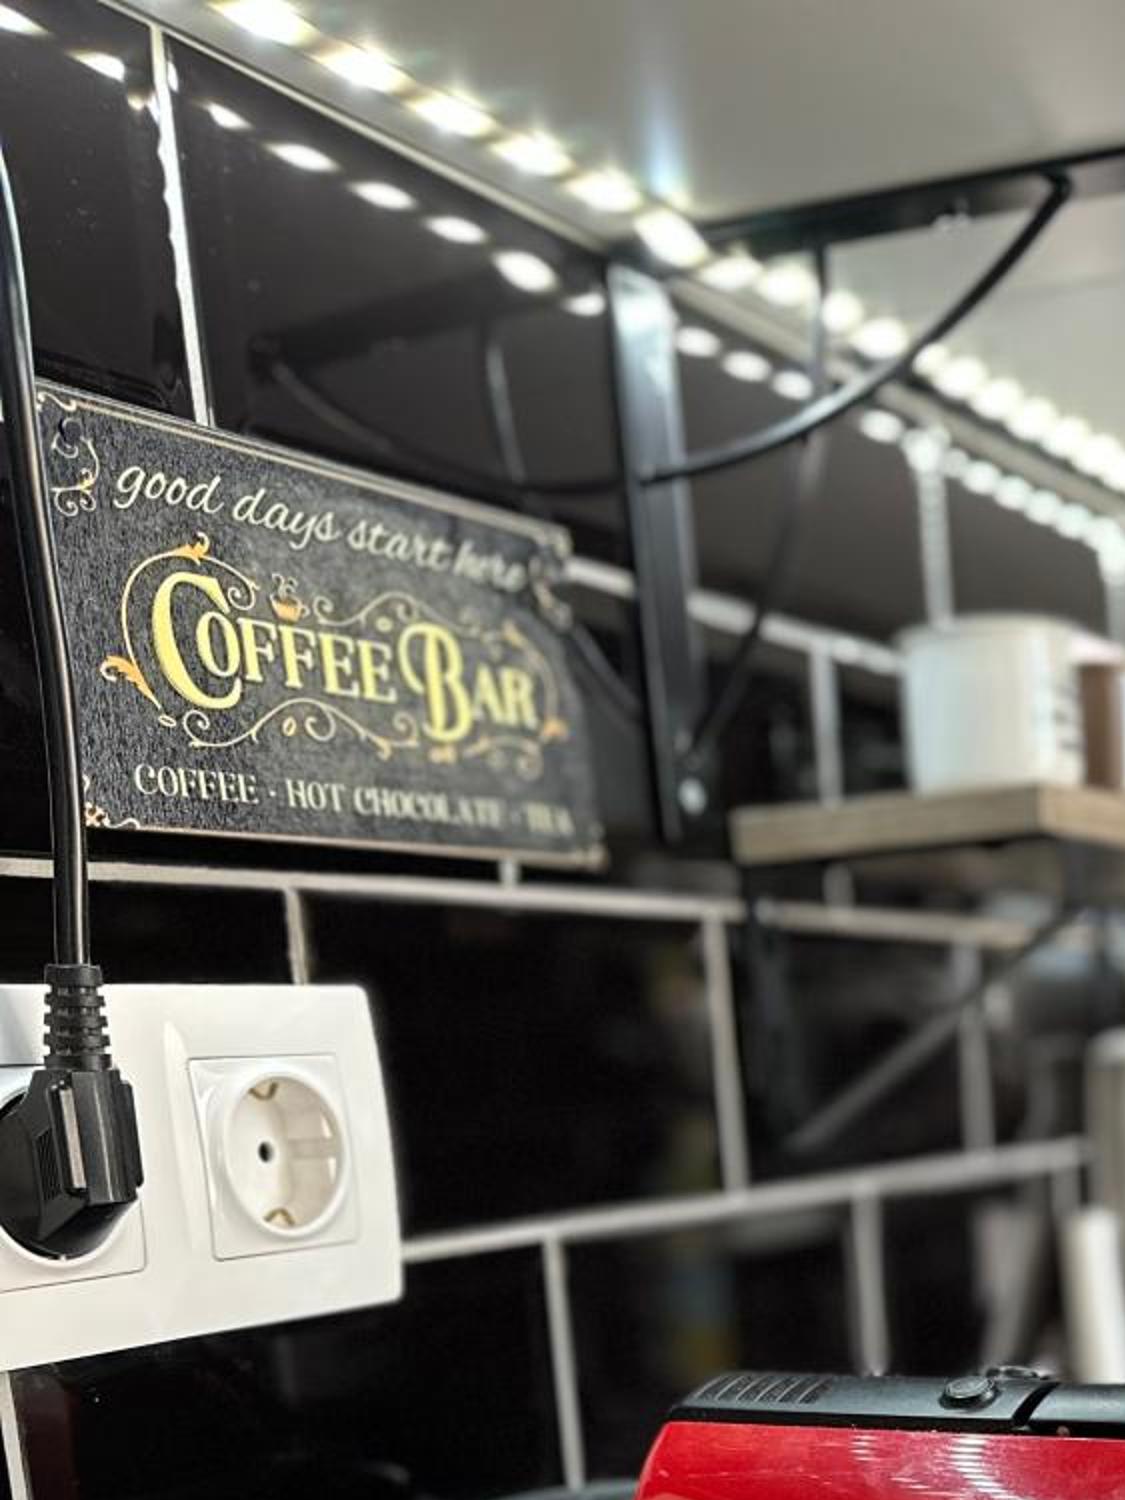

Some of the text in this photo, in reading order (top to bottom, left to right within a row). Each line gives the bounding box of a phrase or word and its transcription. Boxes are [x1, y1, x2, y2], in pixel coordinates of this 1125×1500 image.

[113, 466, 529, 593] good days start here
[152, 571, 539, 742] COFFEE BAR
[134, 763, 259, 804] COFFEE
[285, 778, 345, 812] HOT
